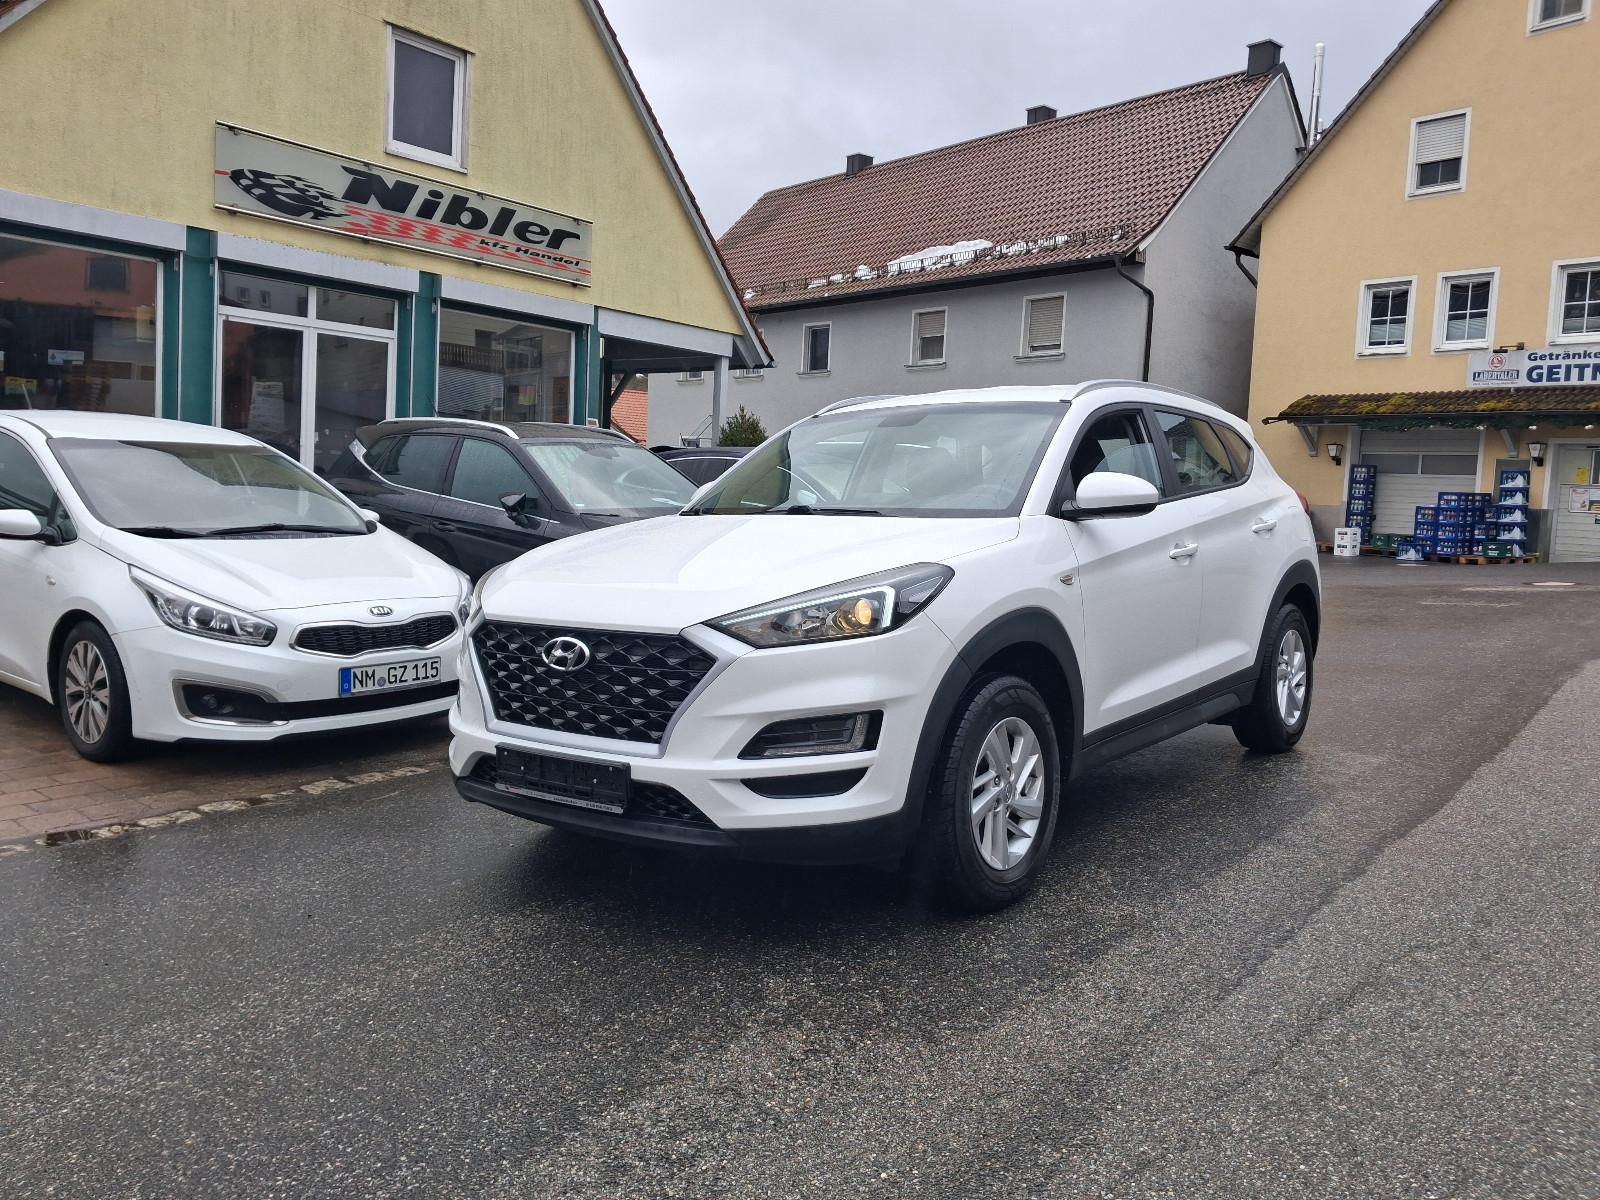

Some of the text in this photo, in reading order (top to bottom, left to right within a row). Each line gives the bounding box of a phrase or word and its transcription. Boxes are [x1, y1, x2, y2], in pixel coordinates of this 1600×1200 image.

[341, 165, 581, 250] Nibler
[515, 247, 580, 267] Handel
[1527, 350, 1600, 362] Getränke
[371, 606, 391, 615] KIA
[352, 669, 376, 689] NM
[387, 665, 408, 684] GZ
[412, 661, 439, 681] 115
